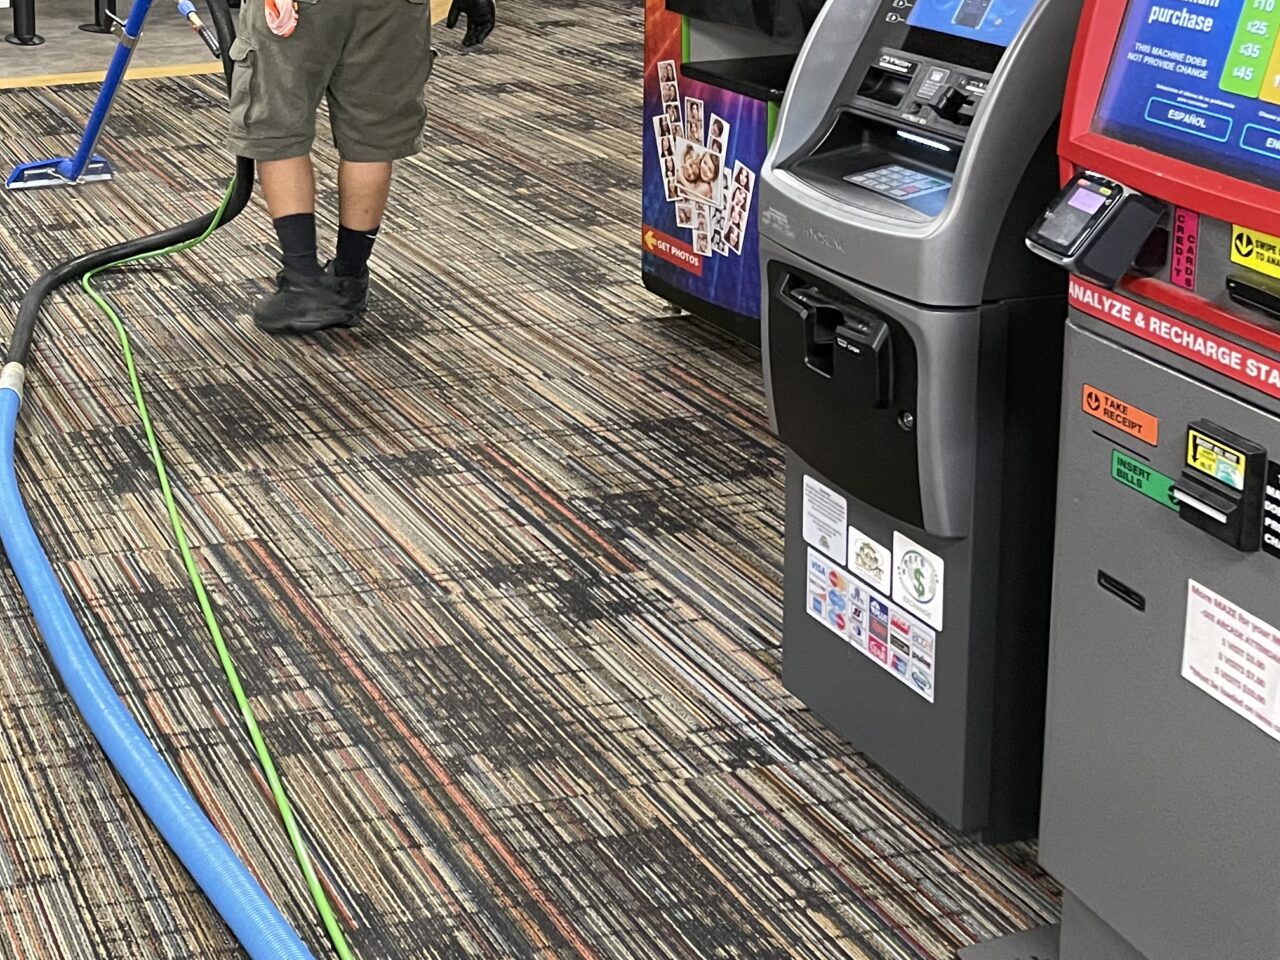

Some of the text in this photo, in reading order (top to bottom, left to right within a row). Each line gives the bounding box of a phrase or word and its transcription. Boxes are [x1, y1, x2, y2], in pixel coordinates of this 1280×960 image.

[1148, 5, 1214, 33] purchase
[1246, 20, 1268, 35] $25
[1135, 42, 1208, 68] THIS MACHINE DOES
[1239, 42, 1262, 58] $35
[1127, 51, 1209, 80] NOT PROVIDE CHANGE
[1232, 66, 1254, 81] $45
[1167, 108, 1207, 129] ESPAÑOL
[657, 239, 700, 267] GET PHOTOS
[1174, 214, 1186, 277] CREDIT
[1255, 239, 1276, 255] SWIPE
[1255, 251, 1265, 261] TO
[1184, 234, 1195, 288] CARDS
[1069, 281, 1132, 323] ANALYZE
[1134, 311, 1146, 328] &
[1149, 316, 1243, 371] RECHARGE
[1104, 396, 1128, 415] TAKE
[1103, 408, 1143, 434] RECEIPT
[1116, 469, 1143, 489] BILLS
[1117, 456, 1151, 481] INSERT
[811, 560, 826, 577] VISA
